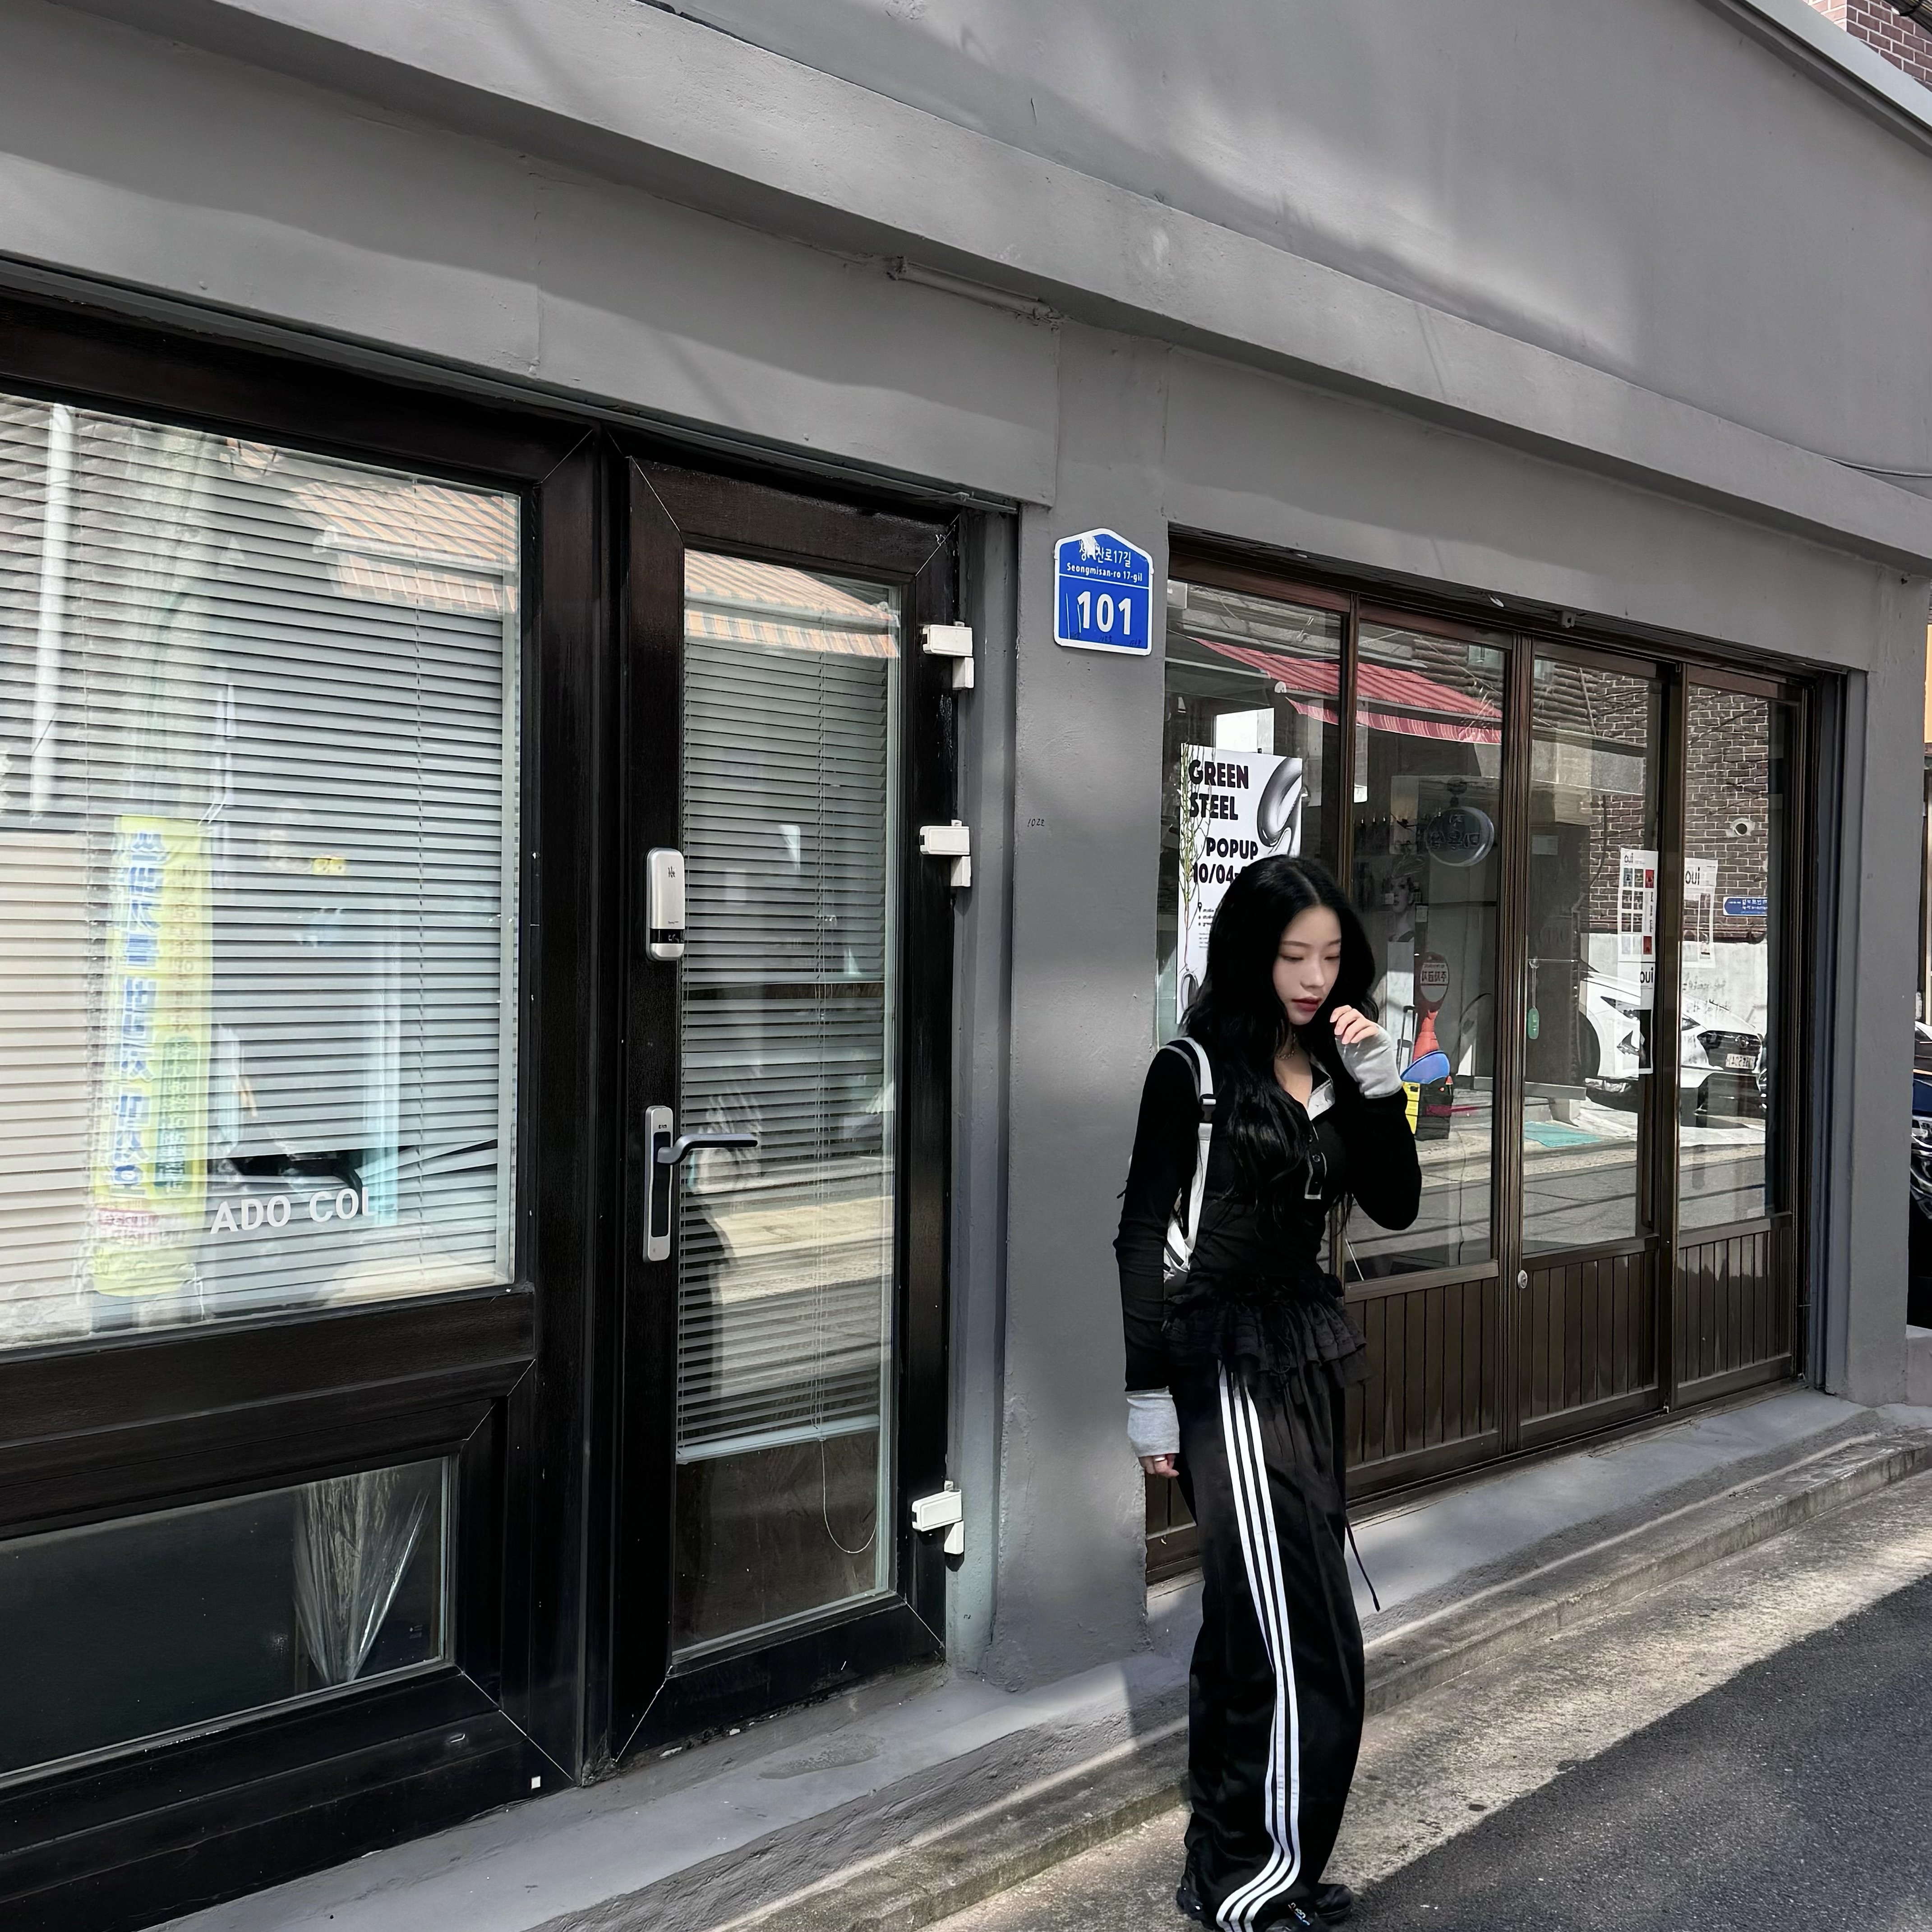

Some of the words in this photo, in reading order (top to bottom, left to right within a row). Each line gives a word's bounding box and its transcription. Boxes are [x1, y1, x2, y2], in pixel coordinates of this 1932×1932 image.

[1067, 562, 1120, 578] Seongmisan-ro
[1123, 571, 1142, 583] 17-gil
[1077, 591, 1131, 635] 101
[1188, 759, 1249, 789] GREEN
[1189, 792, 1238, 820] STEEL
[1206, 837, 1259, 860] POPUP
[1192, 862, 1246, 884] 10/04-
[1685, 866, 1700, 885] oui
[1640, 967, 1654, 984] oui
[210, 1195, 291, 1234] ADO
